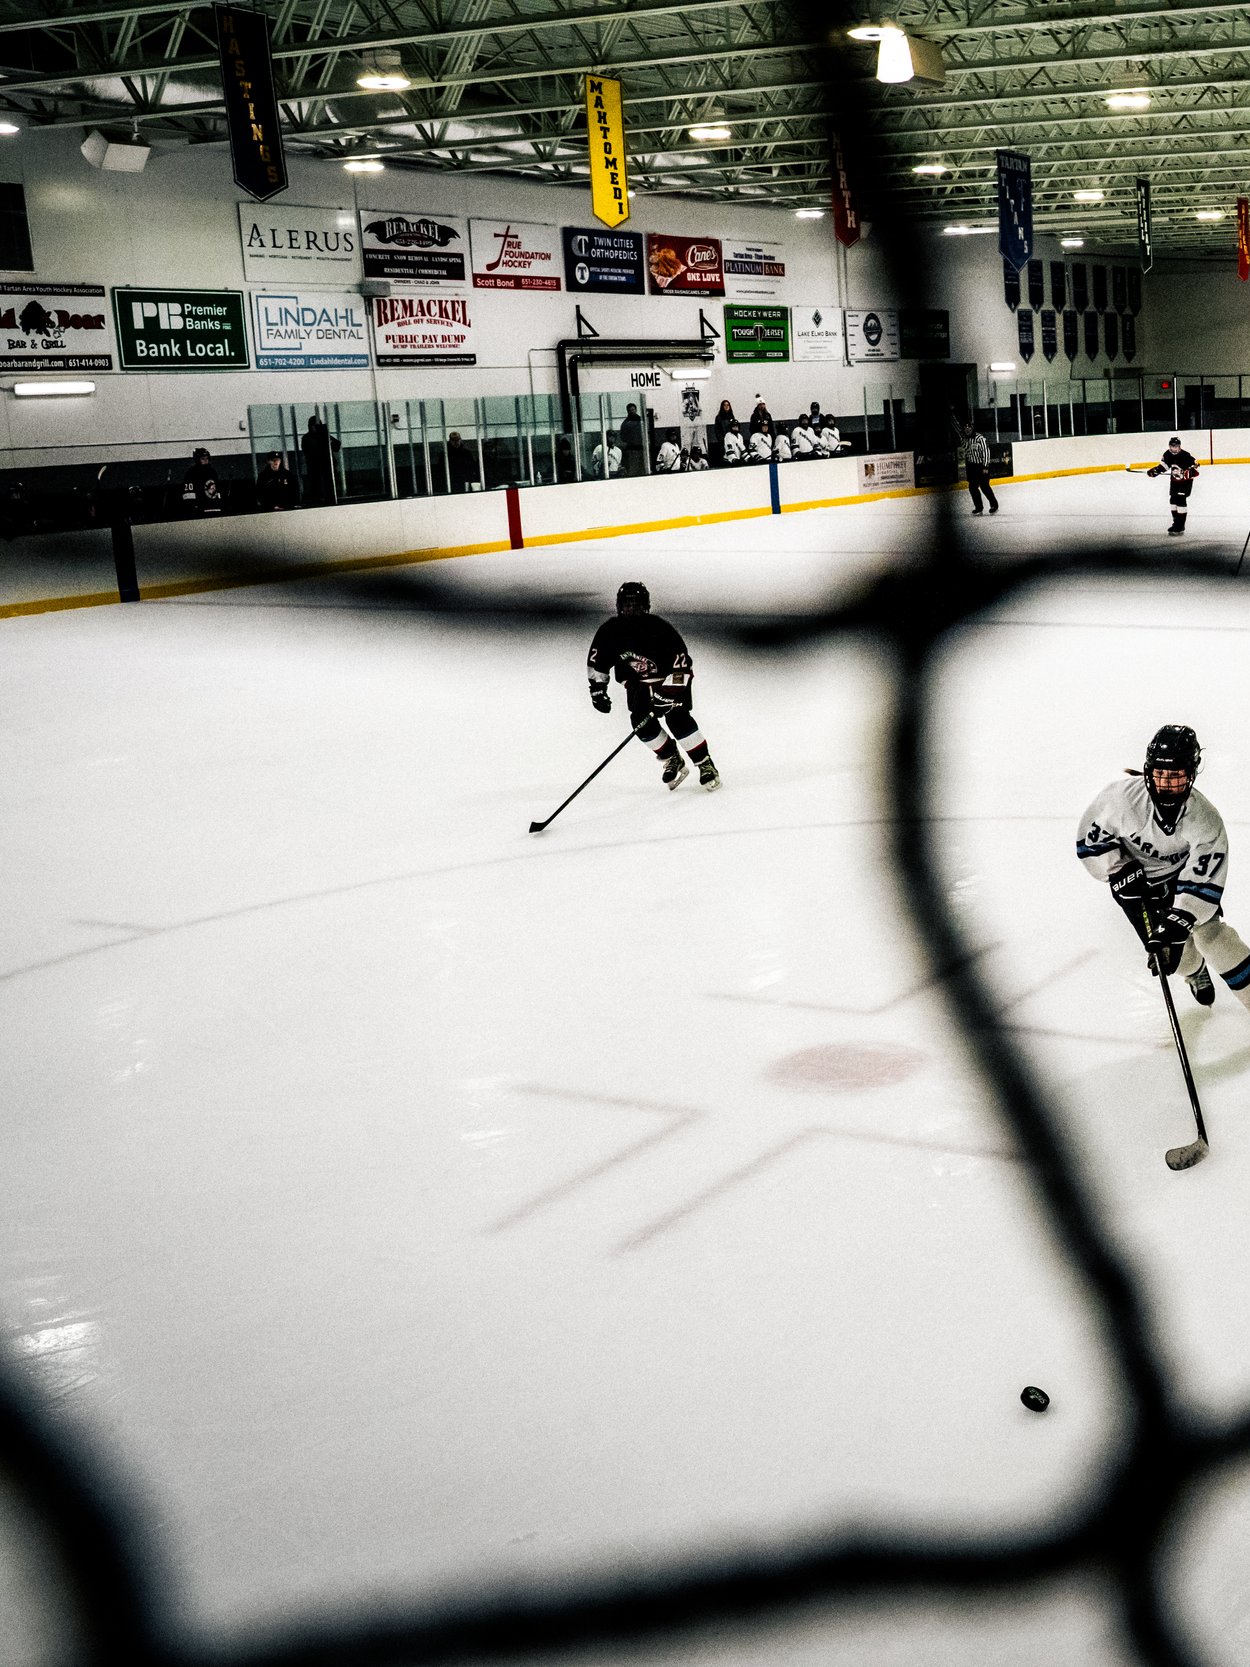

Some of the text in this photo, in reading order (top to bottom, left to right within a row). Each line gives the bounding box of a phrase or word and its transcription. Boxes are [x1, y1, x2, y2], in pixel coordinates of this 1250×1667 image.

[222, 15, 278, 183] HASTINGS
[589, 80, 624, 215] MAHTOMEDI
[247, 223, 354, 252] ALERUS
[385, 221, 441, 242] REMACKEL
[594, 236, 634, 248] TWIN CITIES
[504, 250, 551, 260] FOUNDATION
[591, 248, 638, 260] ORTHOPEDICS
[688, 245, 717, 266] Cane's
[502, 260, 532, 268] HOCKEY
[725, 262, 762, 273] PLATINUM
[765, 264, 784, 274] BANK
[476, 278, 495, 286] Scott
[496, 279, 514, 287] Bond
[686, 272, 701, 281] ONE
[701, 273, 720, 282] LOVE
[184, 303, 227, 315] Premier
[375, 298, 471, 328] REMACKEL
[264, 307, 363, 327] LINDAHL
[426, 319, 453, 327] SERVICES
[185, 318, 220, 330] Banks
[266, 329, 364, 339] FAMILY DENTAL
[385, 335, 466, 343] PUBLIC PAY DUMP
[732, 328, 755, 339] TOUGH
[7, 339, 66, 349] BAR & GRILL
[136, 339, 235, 357] Bank Local.
[69, 359, 109, 367] 651-414-0903
[259, 358, 305, 366] 651-702-4200
[631, 372, 661, 387] HOME
[184, 483, 194, 491] 20
[673, 653, 688, 669] 22
[1088, 821, 1116, 843] 37
[1192, 852, 1225, 878] 37
